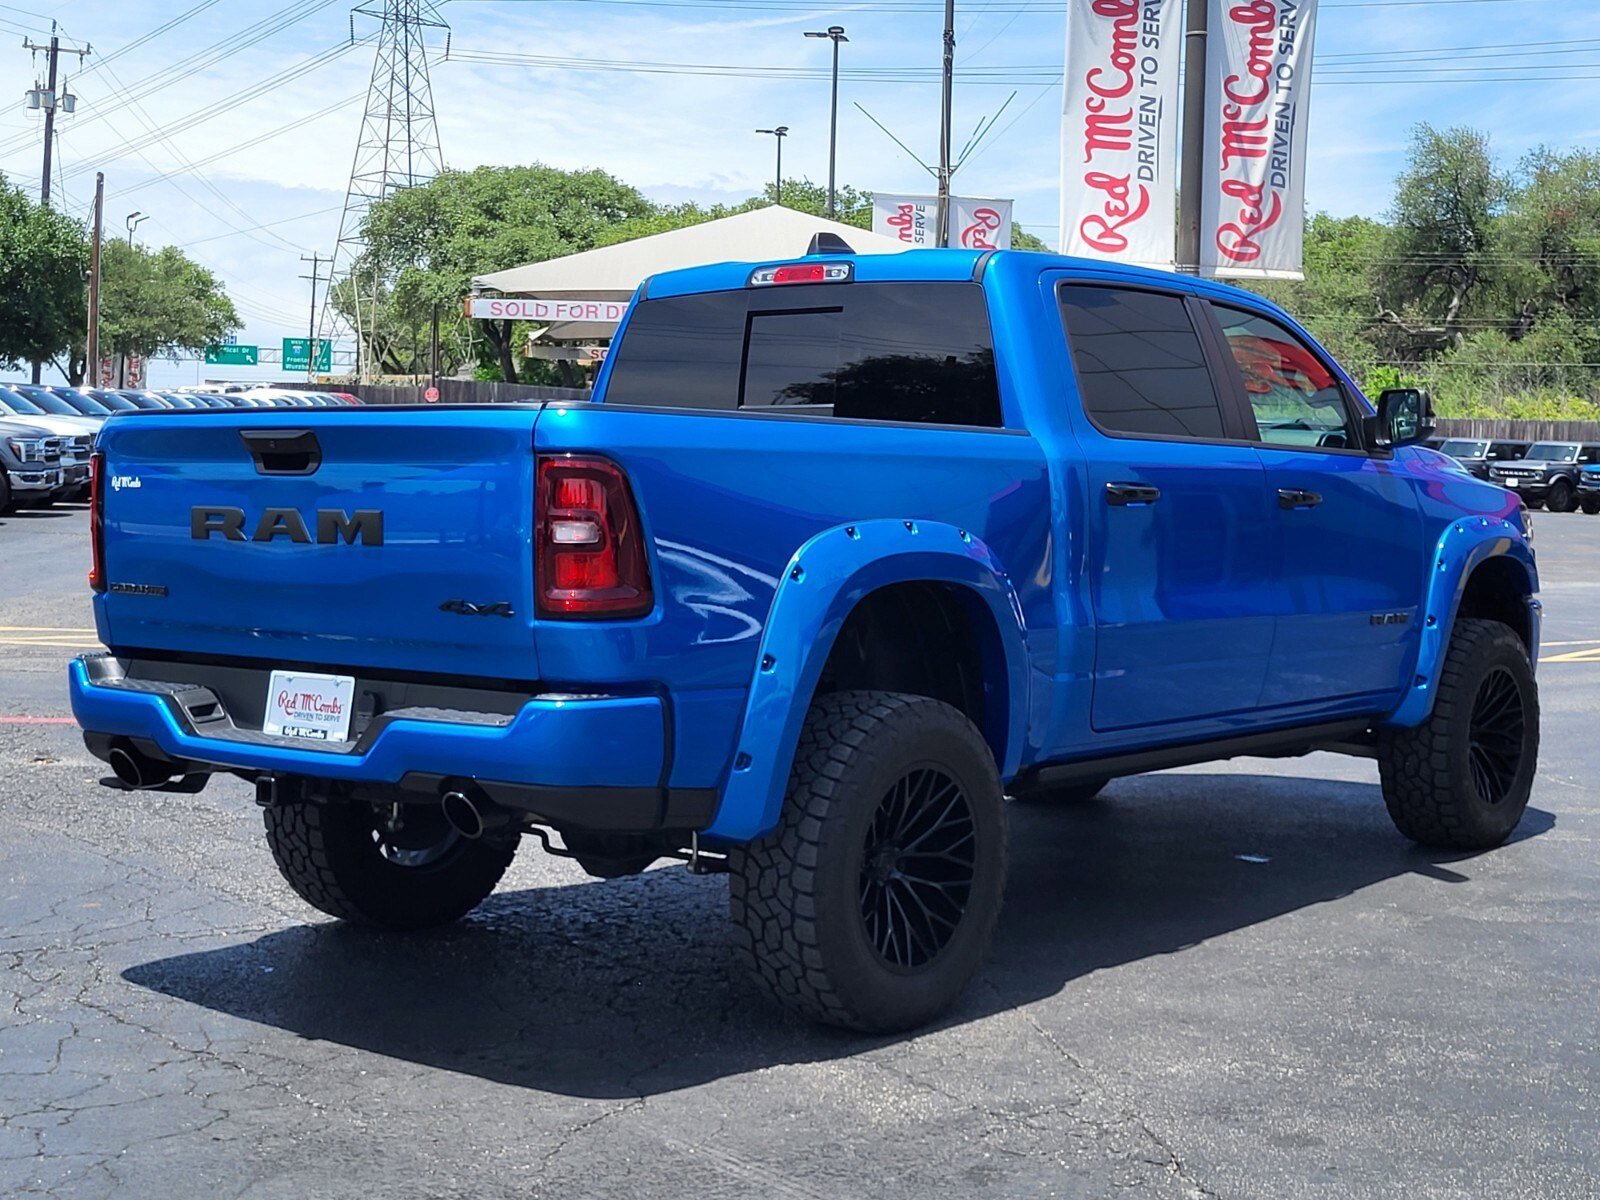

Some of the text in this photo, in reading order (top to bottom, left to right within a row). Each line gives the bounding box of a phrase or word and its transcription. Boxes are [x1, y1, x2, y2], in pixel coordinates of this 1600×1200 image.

[1137, 0, 1161, 182] DRIVEN TO SER
[1270, 0, 1298, 188] DRIVEN TO SERV
[1080, 0, 1150, 253] Red McComb
[1216, 0, 1282, 262] Red McComb
[915, 203, 926, 244] SERVE
[961, 207, 1001, 249] Red
[490, 301, 549, 318] SOLD
[556, 304, 599, 319] FOR
[191, 505, 384, 546] RAM
[278, 690, 342, 715] Red McCombs
[294, 711, 314, 720] DRIVEN
[324, 714, 341, 722] SERVE
